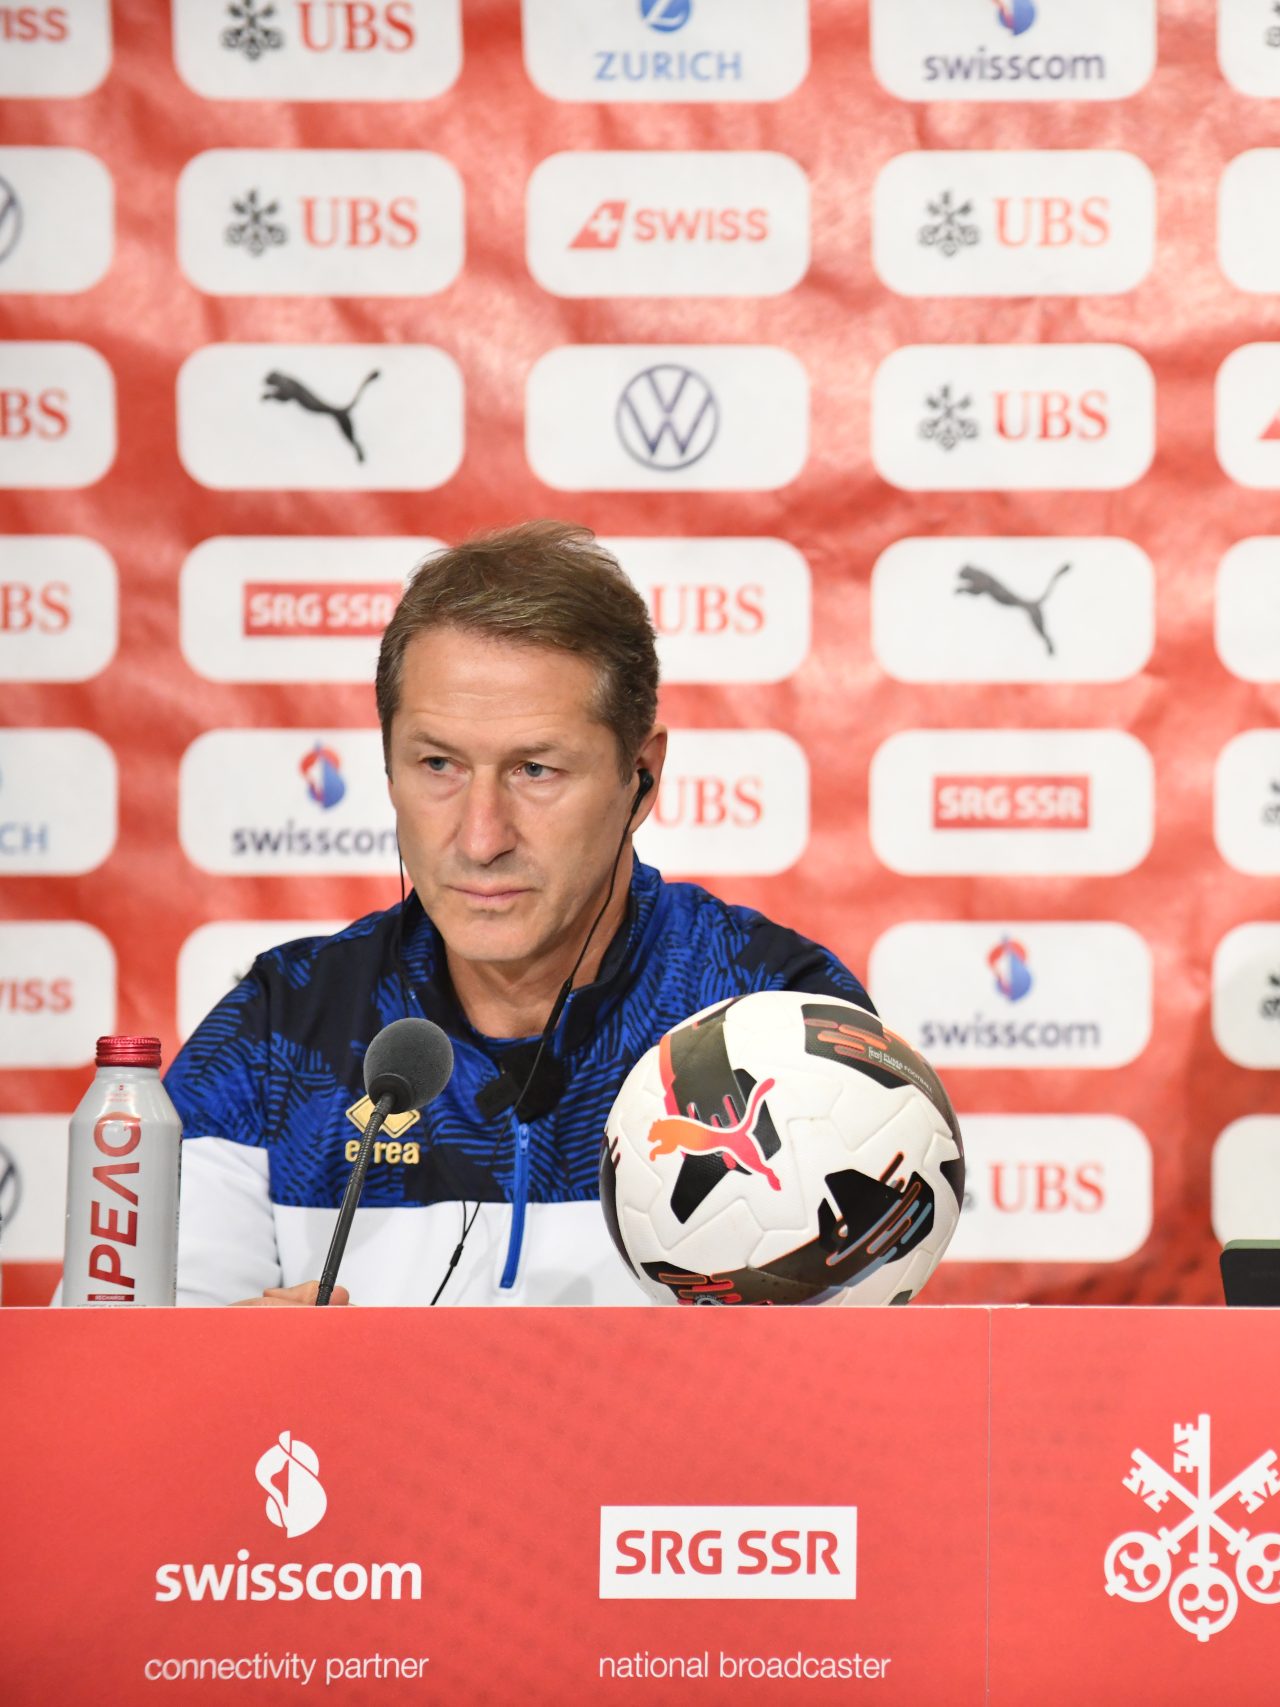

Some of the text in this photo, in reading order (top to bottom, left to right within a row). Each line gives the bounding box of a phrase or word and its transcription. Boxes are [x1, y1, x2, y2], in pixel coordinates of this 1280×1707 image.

[299, 2, 414, 51] UBS
[595, 52, 742, 80] ZURICH
[924, 46, 1104, 81] swisscom
[304, 198, 418, 247] UBS
[635, 209, 768, 244] SWISS
[996, 198, 1109, 247] UBS
[996, 394, 1108, 440] UBS
[251, 592, 321, 628] SRG
[652, 584, 764, 635] UBS
[655, 776, 763, 828] UBS
[939, 785, 1083, 820] SRG SSR
[920, 1013, 1099, 1050] swisscom
[345, 1140, 420, 1164] erea
[992, 1164, 1104, 1211] UBS
[616, 1530, 840, 1575] SRG SSR
[156, 1549, 422, 1602] swisscom
[144, 1652, 429, 1685] connectivity partner
[600, 1651, 891, 1678] national broadcaster
